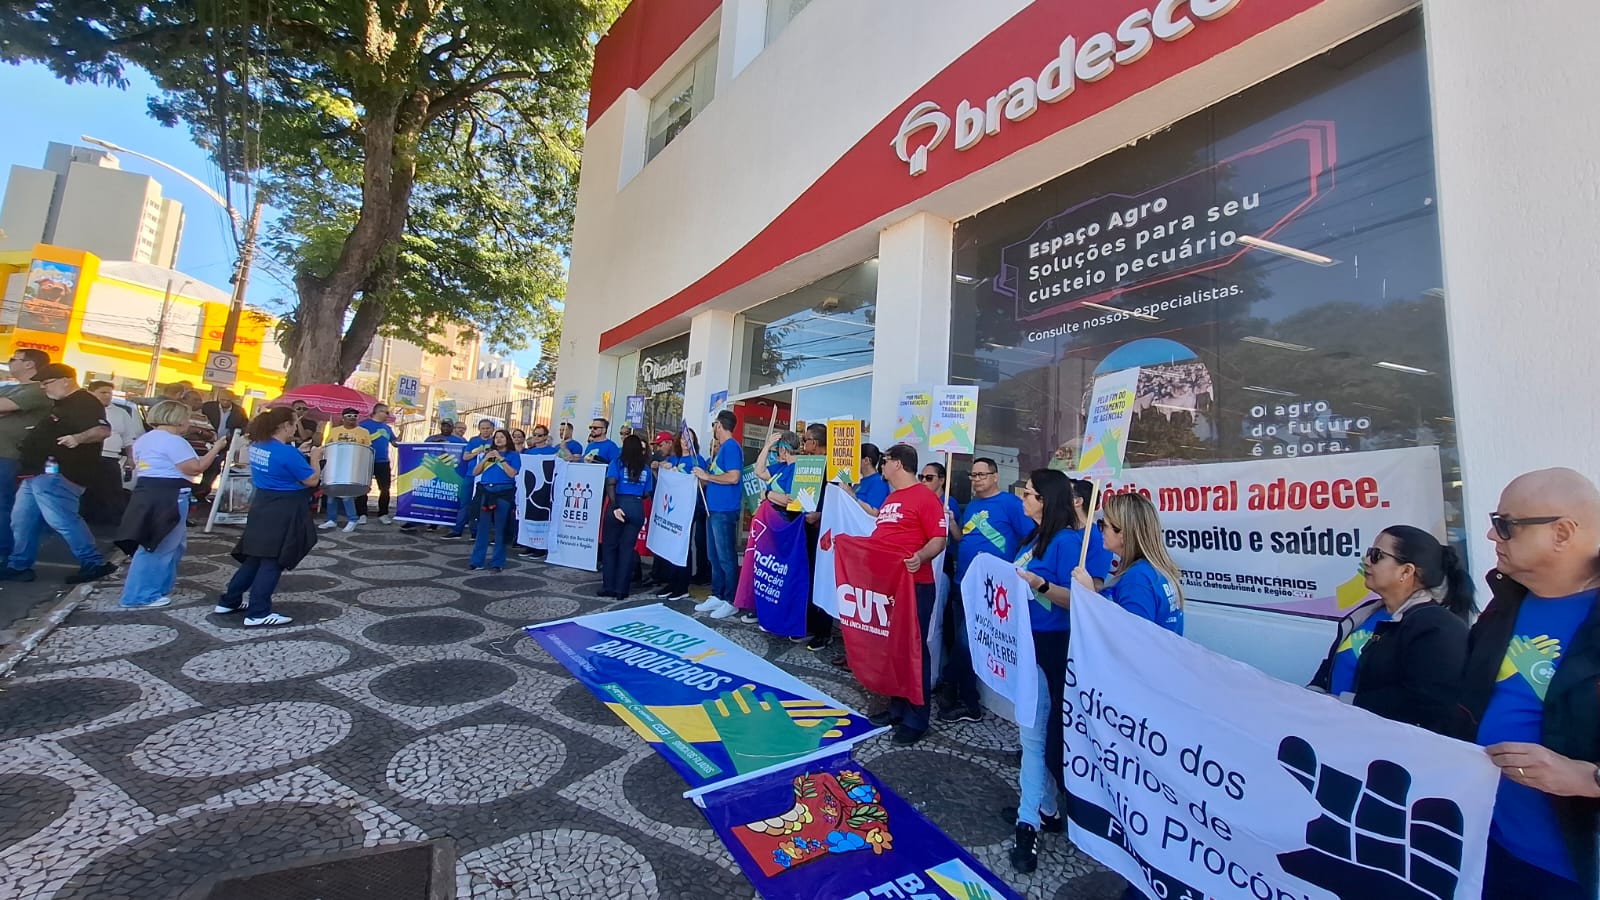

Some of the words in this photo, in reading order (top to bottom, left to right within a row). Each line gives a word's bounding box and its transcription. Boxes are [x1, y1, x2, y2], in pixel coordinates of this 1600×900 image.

[1029, 222, 1100, 259] Espaço
[1108, 197, 1168, 230] Agro
[1029, 237, 1126, 281] Soluções
[1136, 213, 1196, 250] para
[1207, 192, 1260, 223] seu
[1029, 269, 1106, 303] custeio
[1116, 230, 1237, 282] pecuário
[1028, 322, 1080, 342] Consulte
[1083, 310, 1130, 329] nossos
[1134, 284, 1244, 319] especialistas.
[400, 378, 417, 390] PLR
[1098, 394, 1108, 404] PELO
[1109, 393, 1118, 401] FIM
[1118, 390, 1126, 398] DO
[1095, 401, 1125, 414] FECHAMENTO
[1251, 405, 1264, 418] O
[1275, 401, 1328, 418] agro
[1093, 415, 1099, 423] DE
[1252, 423, 1276, 437] do
[1288, 418, 1370, 434] futuro
[834, 427, 844, 437] FIM
[846, 427, 854, 437] DO
[833, 448, 853, 457] MORAL
[1252, 443, 1264, 456] é
[1273, 441, 1350, 457] agora.
[837, 458, 853, 466] SEXUAL
[412, 478, 459, 491] BANCÁRIOS
[1159, 481, 1237, 511] moral
[1248, 475, 1390, 511] adoece.
[563, 509, 588, 521] SEEB
[1162, 526, 1241, 553] espeito
[1249, 531, 1263, 552] e
[1270, 526, 1361, 558] saúde!
[1203, 580, 1255, 593] Chateaubriand
[1264, 586, 1293, 597] Região
[1206, 572, 1231, 582] DOS
[1236, 574, 1317, 591] BANCÁRIOS
[837, 584, 889, 627] CUT
[608, 621, 705, 653] BRASIL
[586, 640, 733, 691] BANQUEIROS
[1180, 744, 1246, 801] dos
[1188, 800, 1232, 842] de
